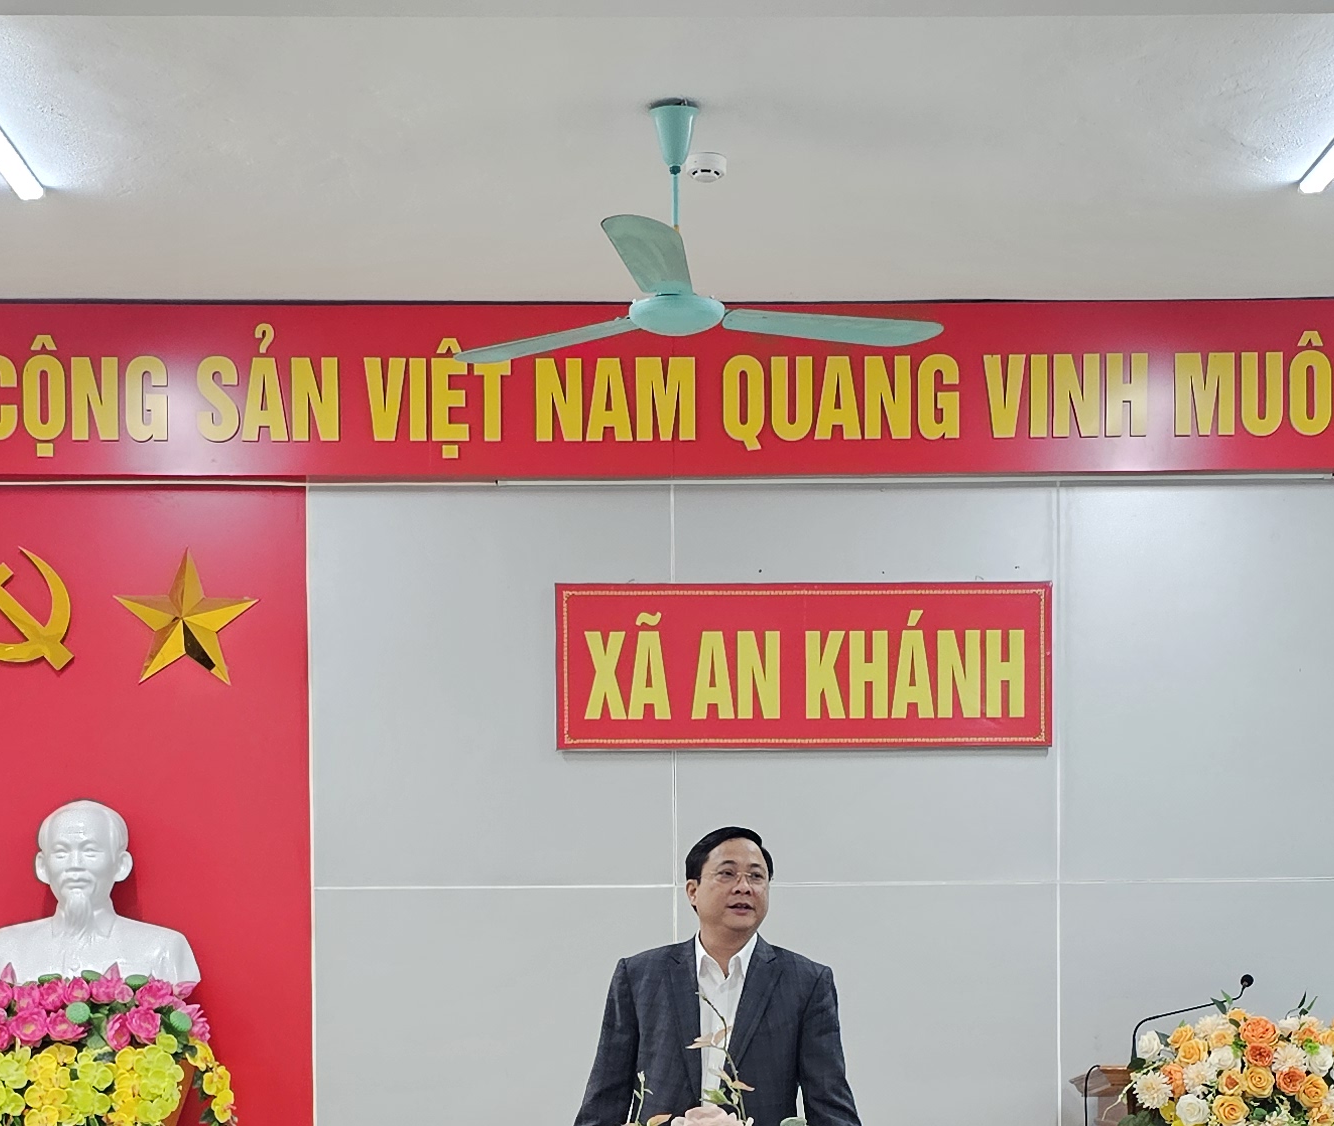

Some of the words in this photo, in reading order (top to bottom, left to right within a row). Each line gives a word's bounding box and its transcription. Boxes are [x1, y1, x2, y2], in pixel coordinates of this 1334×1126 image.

[199, 324, 341, 441] SẢN
[364, 338, 512, 459] VIỆT
[535, 355, 697, 442] NAM
[723, 353, 961, 450] QUANG
[983, 353, 1148, 437] VINH
[583, 611, 672, 720] XÃ
[691, 630, 781, 720] AN
[805, 610, 1025, 720] KHÁNH
